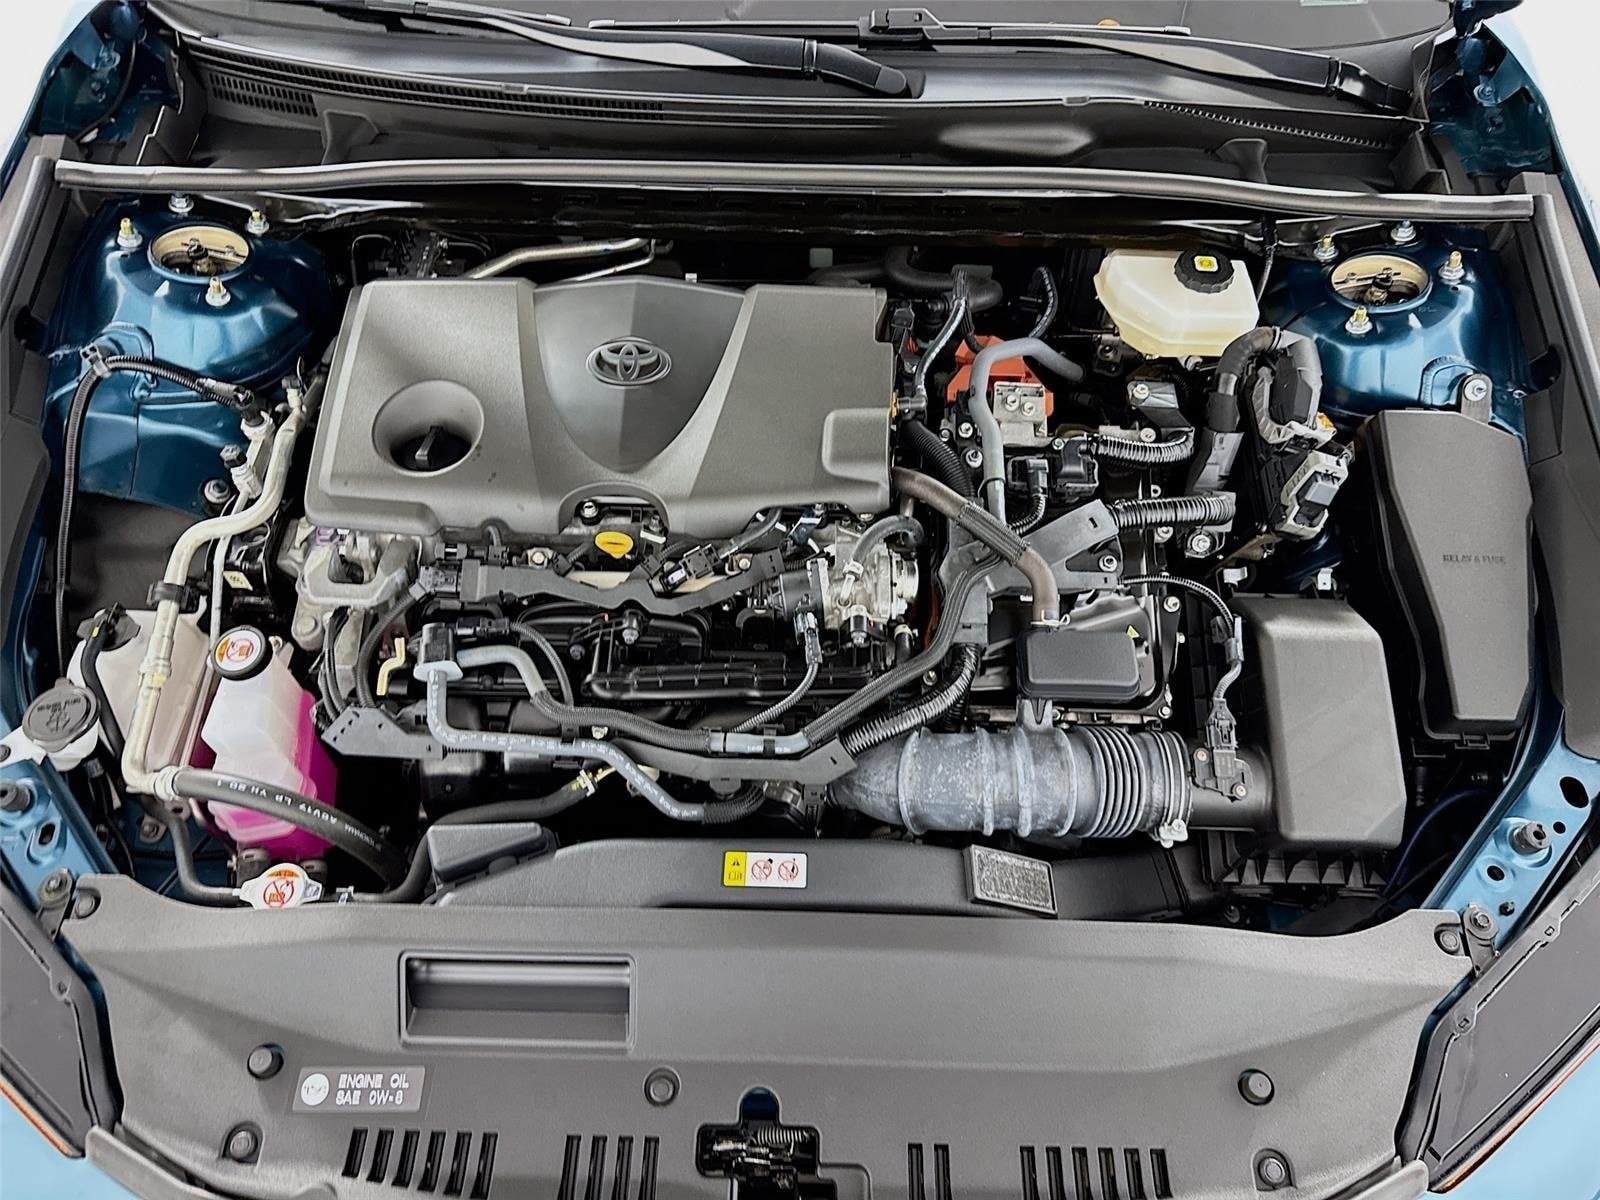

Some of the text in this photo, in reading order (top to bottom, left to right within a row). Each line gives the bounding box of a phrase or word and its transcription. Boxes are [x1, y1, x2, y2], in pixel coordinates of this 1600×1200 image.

[338, 1073, 410, 1089] ENGINE OIL
[336, 1090, 404, 1106] SAE 0W-8
